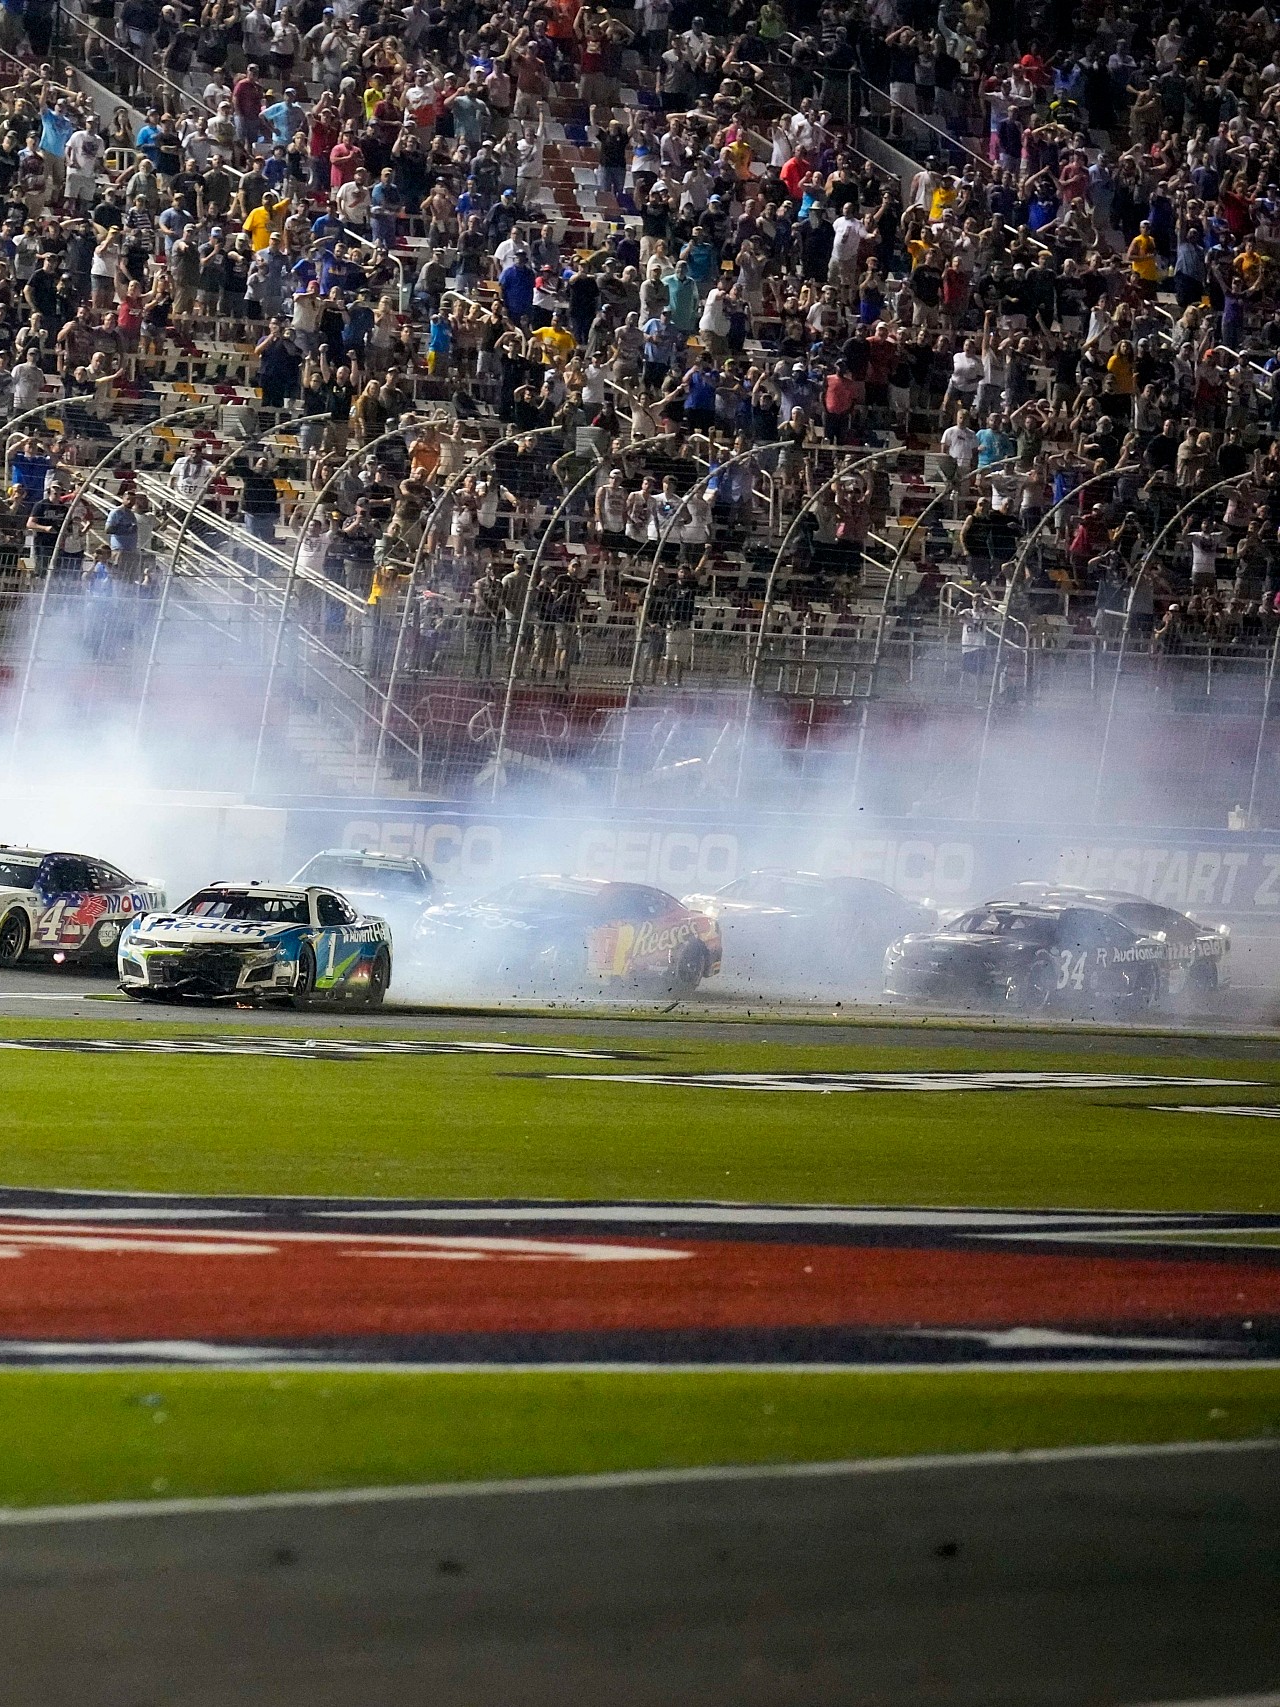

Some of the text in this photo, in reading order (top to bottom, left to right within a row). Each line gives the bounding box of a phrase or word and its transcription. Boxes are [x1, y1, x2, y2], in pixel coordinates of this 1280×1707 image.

[578, 830, 739, 886] GEICO
[39, 898, 67, 941] 4
[105, 892, 150, 914] Mobil
[145, 917, 267, 937] Health
[325, 931, 337, 980] 1
[1056, 949, 1088, 990] 34
